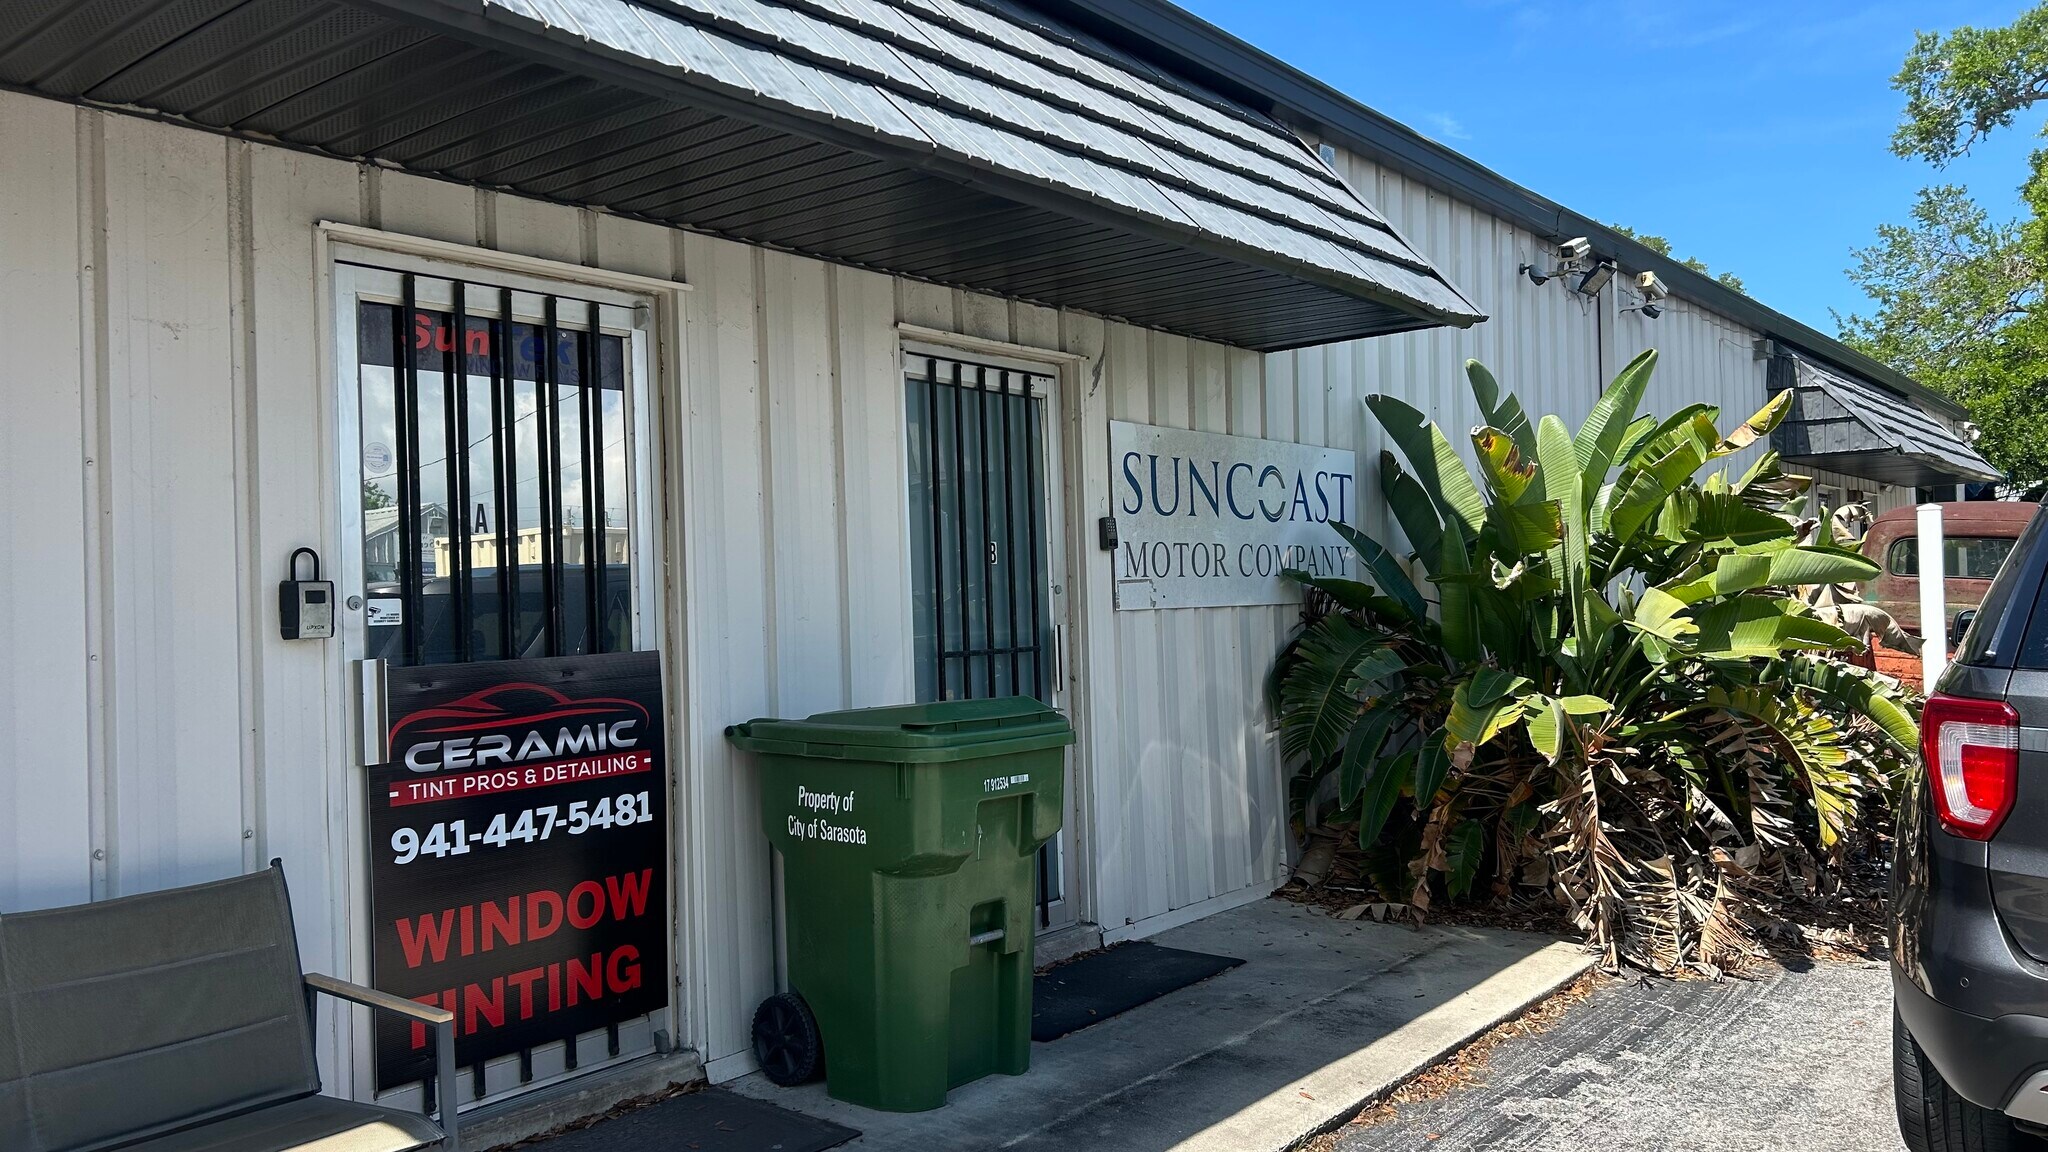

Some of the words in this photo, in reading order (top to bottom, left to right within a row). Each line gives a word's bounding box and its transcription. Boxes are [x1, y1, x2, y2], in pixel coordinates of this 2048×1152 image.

[460, 355, 530, 378] WINDW
[1122, 452, 1352, 524] SUNCOAST
[475, 503, 489, 533] A
[1124, 541, 1229, 578] MOTOR
[1238, 543, 1350, 578] COMPANY
[404, 719, 638, 773] CERAMIC
[408, 779, 457, 800] TINT
[463, 769, 518, 793] PROS
[524, 769, 537, 783] &
[543, 755, 637, 782] DETAILING
[798, 785, 840, 815] Property
[842, 790, 854, 812] of
[391, 791, 653, 864] 941-447-5481
[788, 815, 805, 841] City
[807, 818, 818, 839] of
[820, 819, 867, 844] Sarasota
[395, 868, 653, 968] WINDOW
[408, 944, 642, 1050] TINTING
